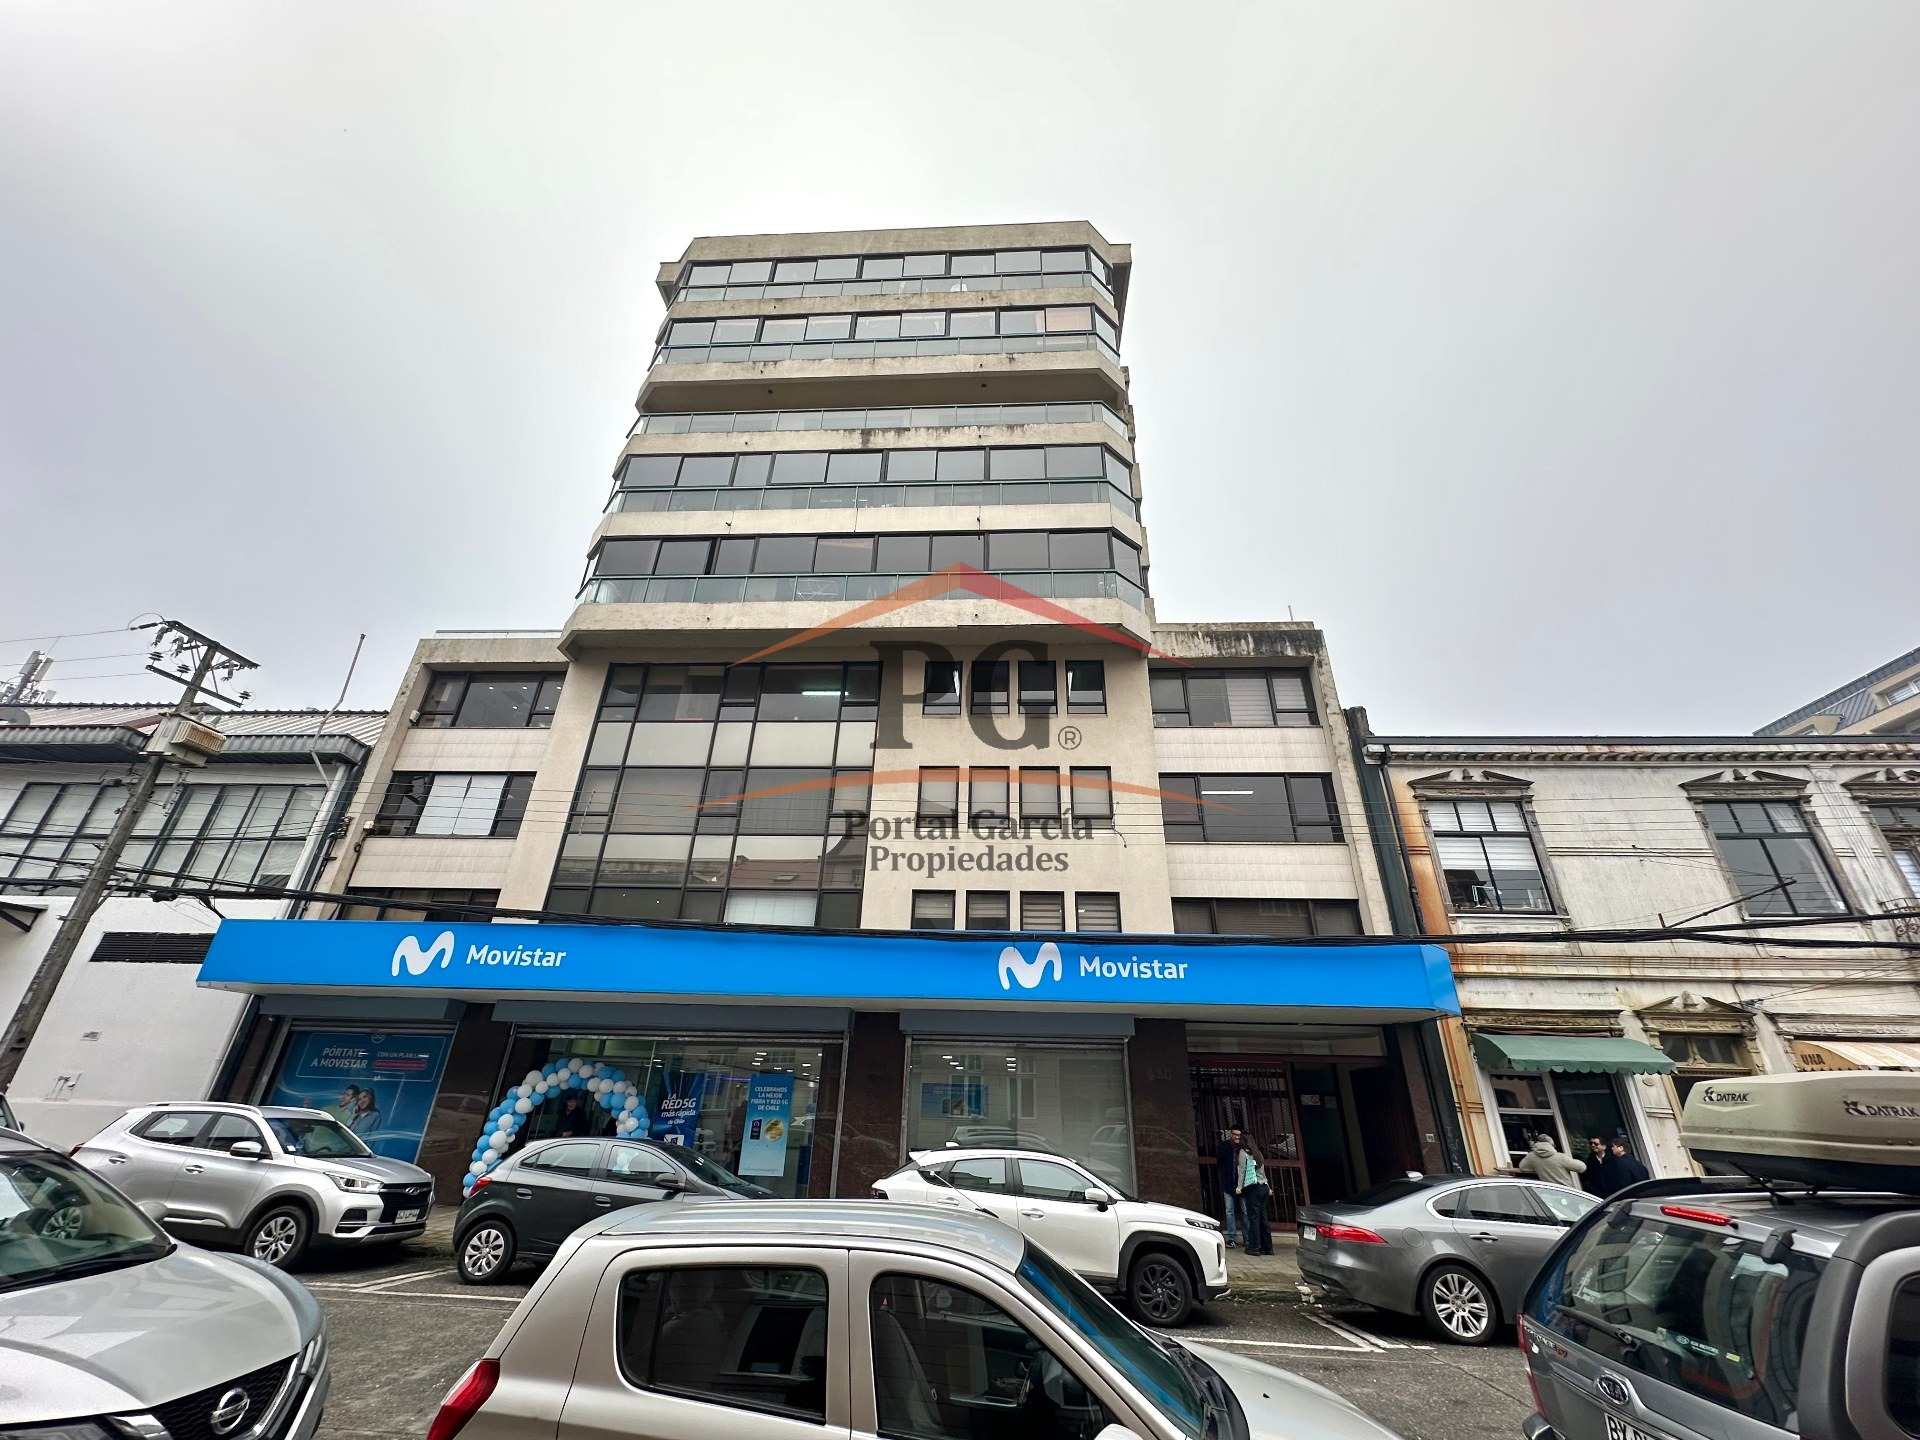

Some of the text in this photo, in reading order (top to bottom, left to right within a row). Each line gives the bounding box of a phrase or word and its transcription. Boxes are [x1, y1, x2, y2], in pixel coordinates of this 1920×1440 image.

[466, 944, 567, 967] Movistar
[1079, 955, 1188, 979] Movistar
[310, 1058, 318, 1067] A
[319, 1058, 368, 1069] MOVISTAR
[1716, 1093, 1749, 1102] DATRAK
[1865, 1105, 1920, 1117] DATRAK
